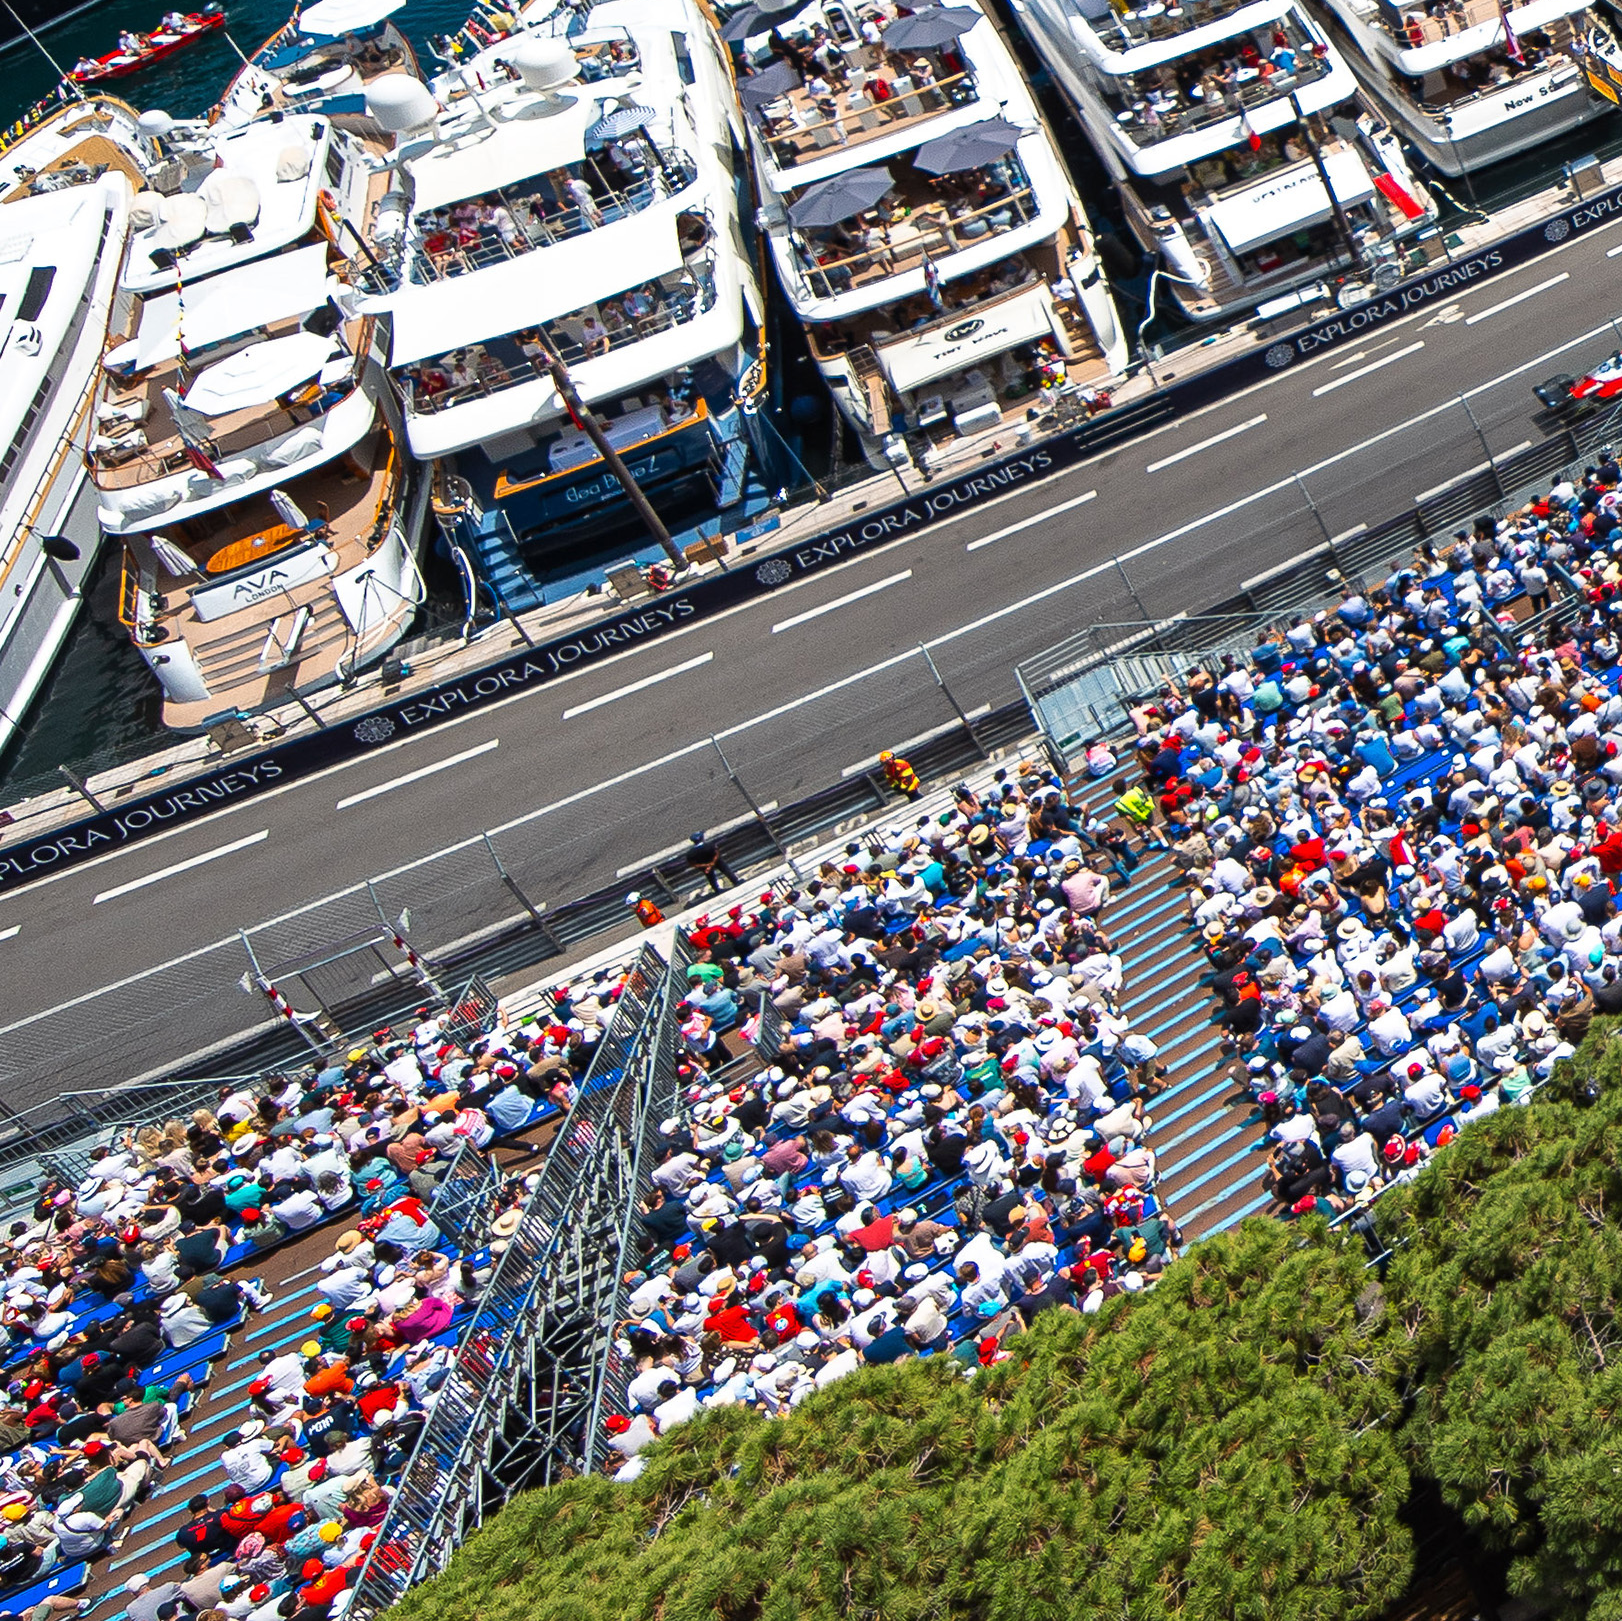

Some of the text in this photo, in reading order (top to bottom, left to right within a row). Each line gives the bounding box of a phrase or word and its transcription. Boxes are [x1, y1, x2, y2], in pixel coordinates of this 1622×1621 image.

[1296, 250, 1504, 354] EXPLORA JOURNEYS
[796, 450, 1053, 569] EXPLORA JOURNEYS
[233, 569, 289, 600] AVA
[244, 583, 285, 603] LONDON
[399, 597, 696, 726] EXPLORA JOURNEYS
[114, 759, 283, 839] JOURNEYS
